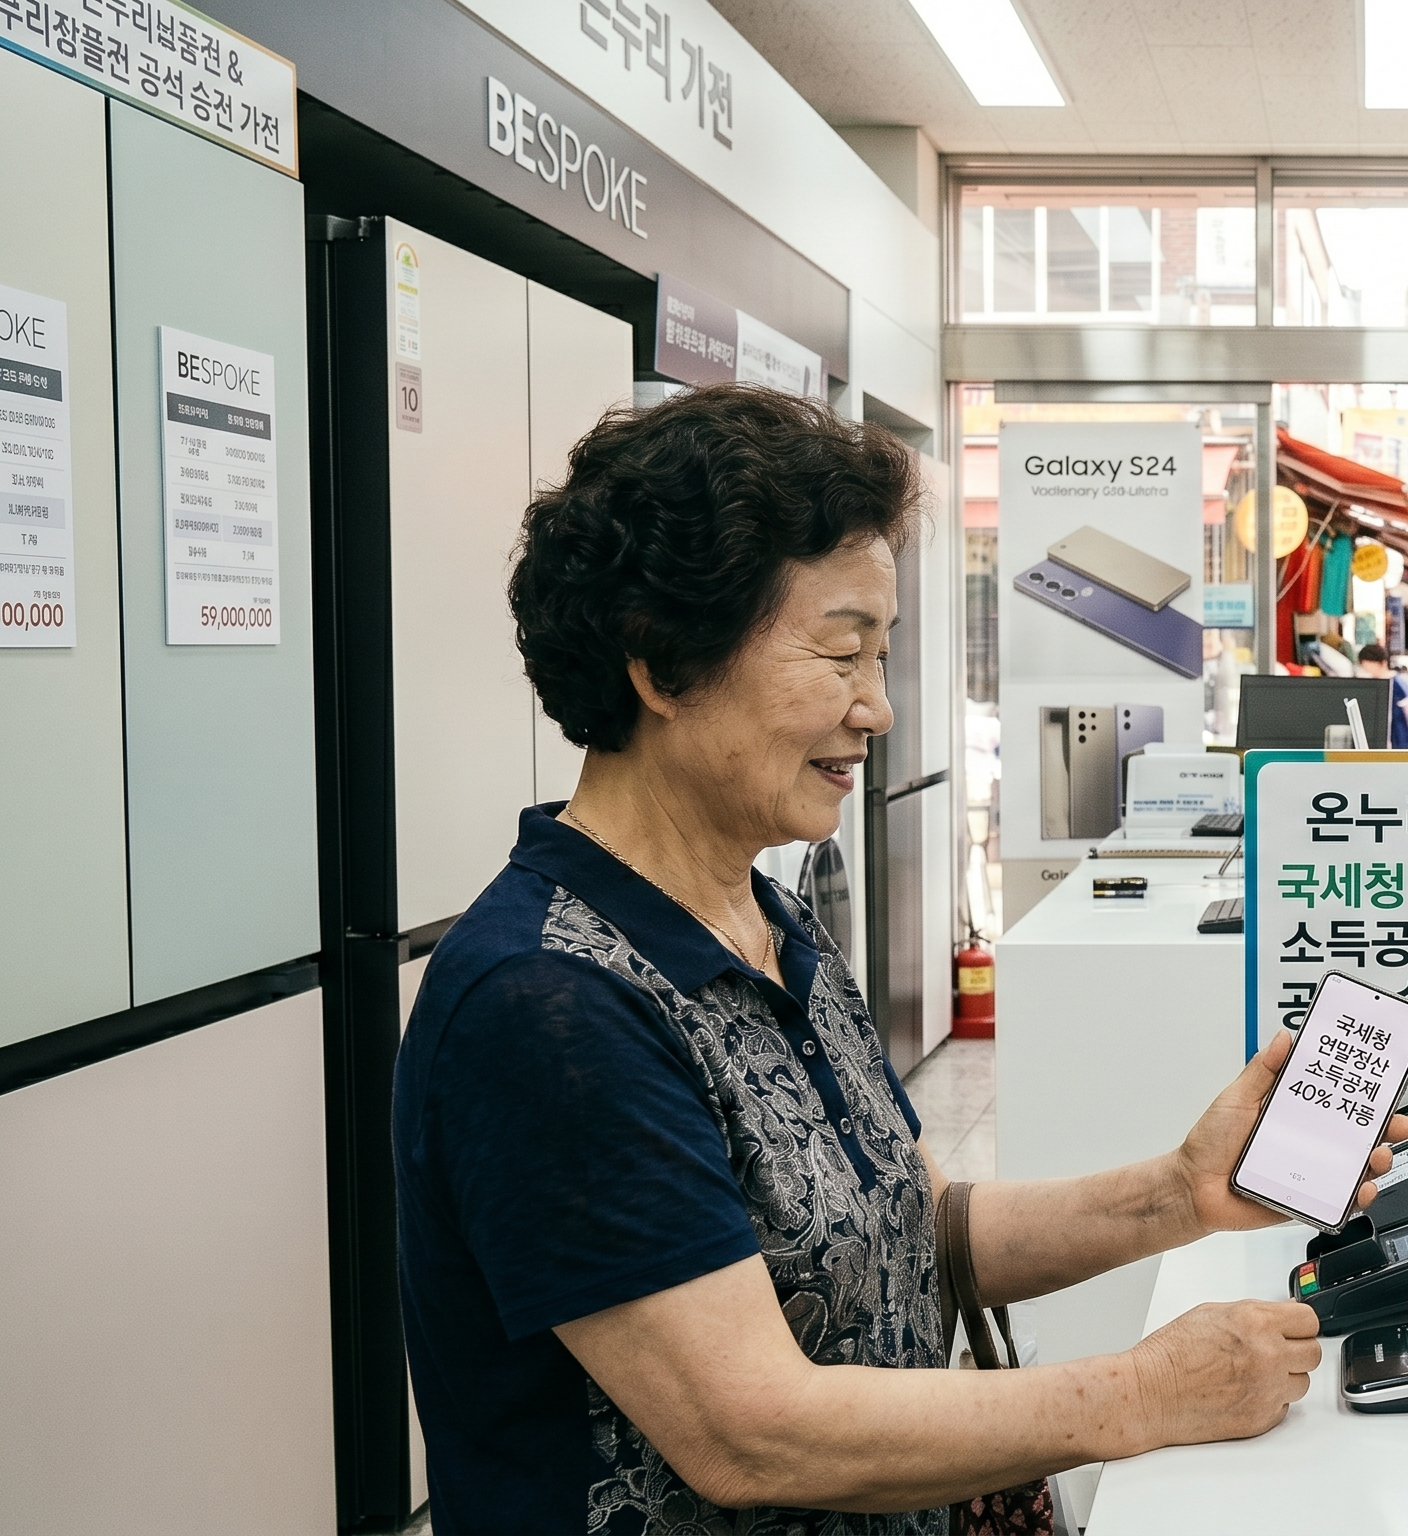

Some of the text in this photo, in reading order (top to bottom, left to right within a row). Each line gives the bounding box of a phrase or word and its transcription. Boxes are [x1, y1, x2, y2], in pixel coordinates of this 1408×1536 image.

[228, 50, 244, 87] &
[681, 38, 733, 151] 가전
[240, 102, 280, 155] 가전
[487, 75, 648, 240] BESPOKE
[178, 350, 261, 397] BESPOKE
[401, 386, 419, 412] 10
[1025, 455, 1178, 483] Galaxy S24
[201, 605, 273, 631] 59,000,000
[1277, 861, 1405, 909] 국세청
[1335, 1013, 1392, 1052] 국세청
[1318, 1033, 1391, 1079] 연말정산
[1288, 1079, 1335, 1110] 40%
[1304, 1059, 1382, 1103] 소득공제
